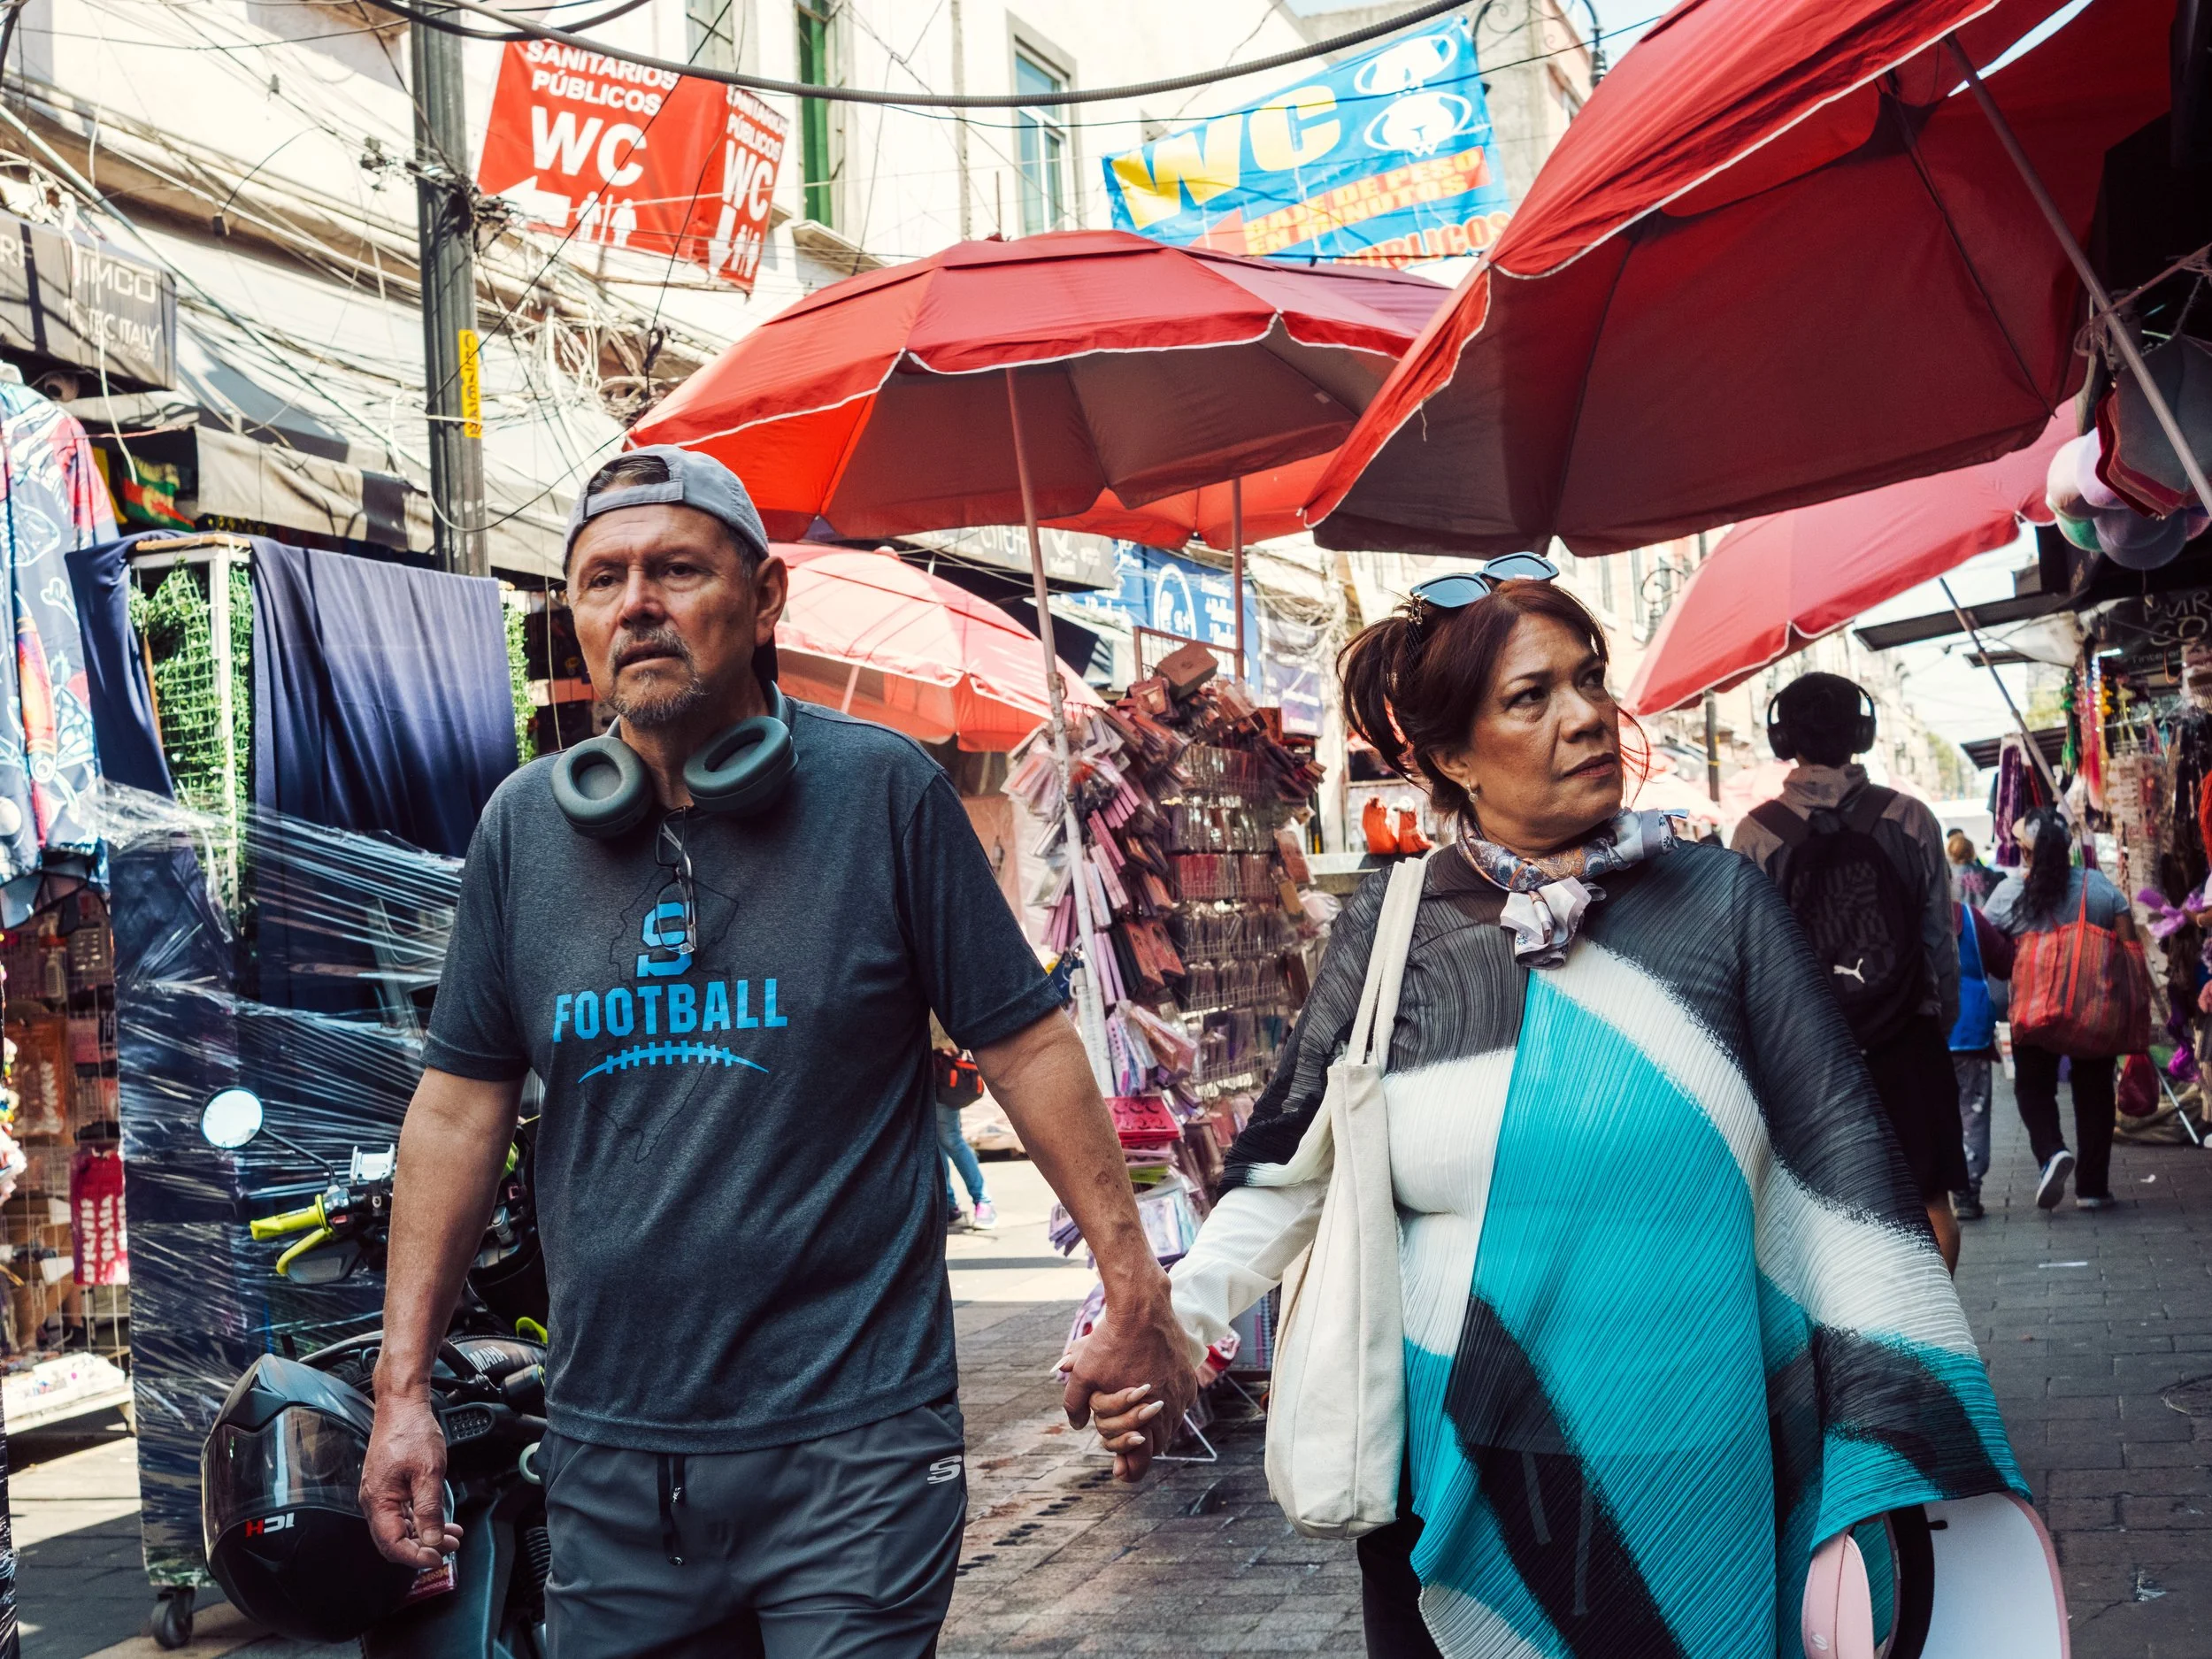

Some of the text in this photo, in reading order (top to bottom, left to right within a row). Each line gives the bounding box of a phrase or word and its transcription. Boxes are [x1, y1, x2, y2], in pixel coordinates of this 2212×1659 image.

[526, 40, 680, 91] SANITARIOS
[532, 70, 663, 117] PÚBLICOS
[532, 105, 648, 187] WC
[1111, 85, 1340, 231] WC
[1386, 150, 1481, 188] PESO
[722, 139, 773, 221] WC
[119, 318, 162, 354] ITALY
[553, 978, 787, 1042] FOOTBALL
[468, 1345, 509, 1372] MAHA
